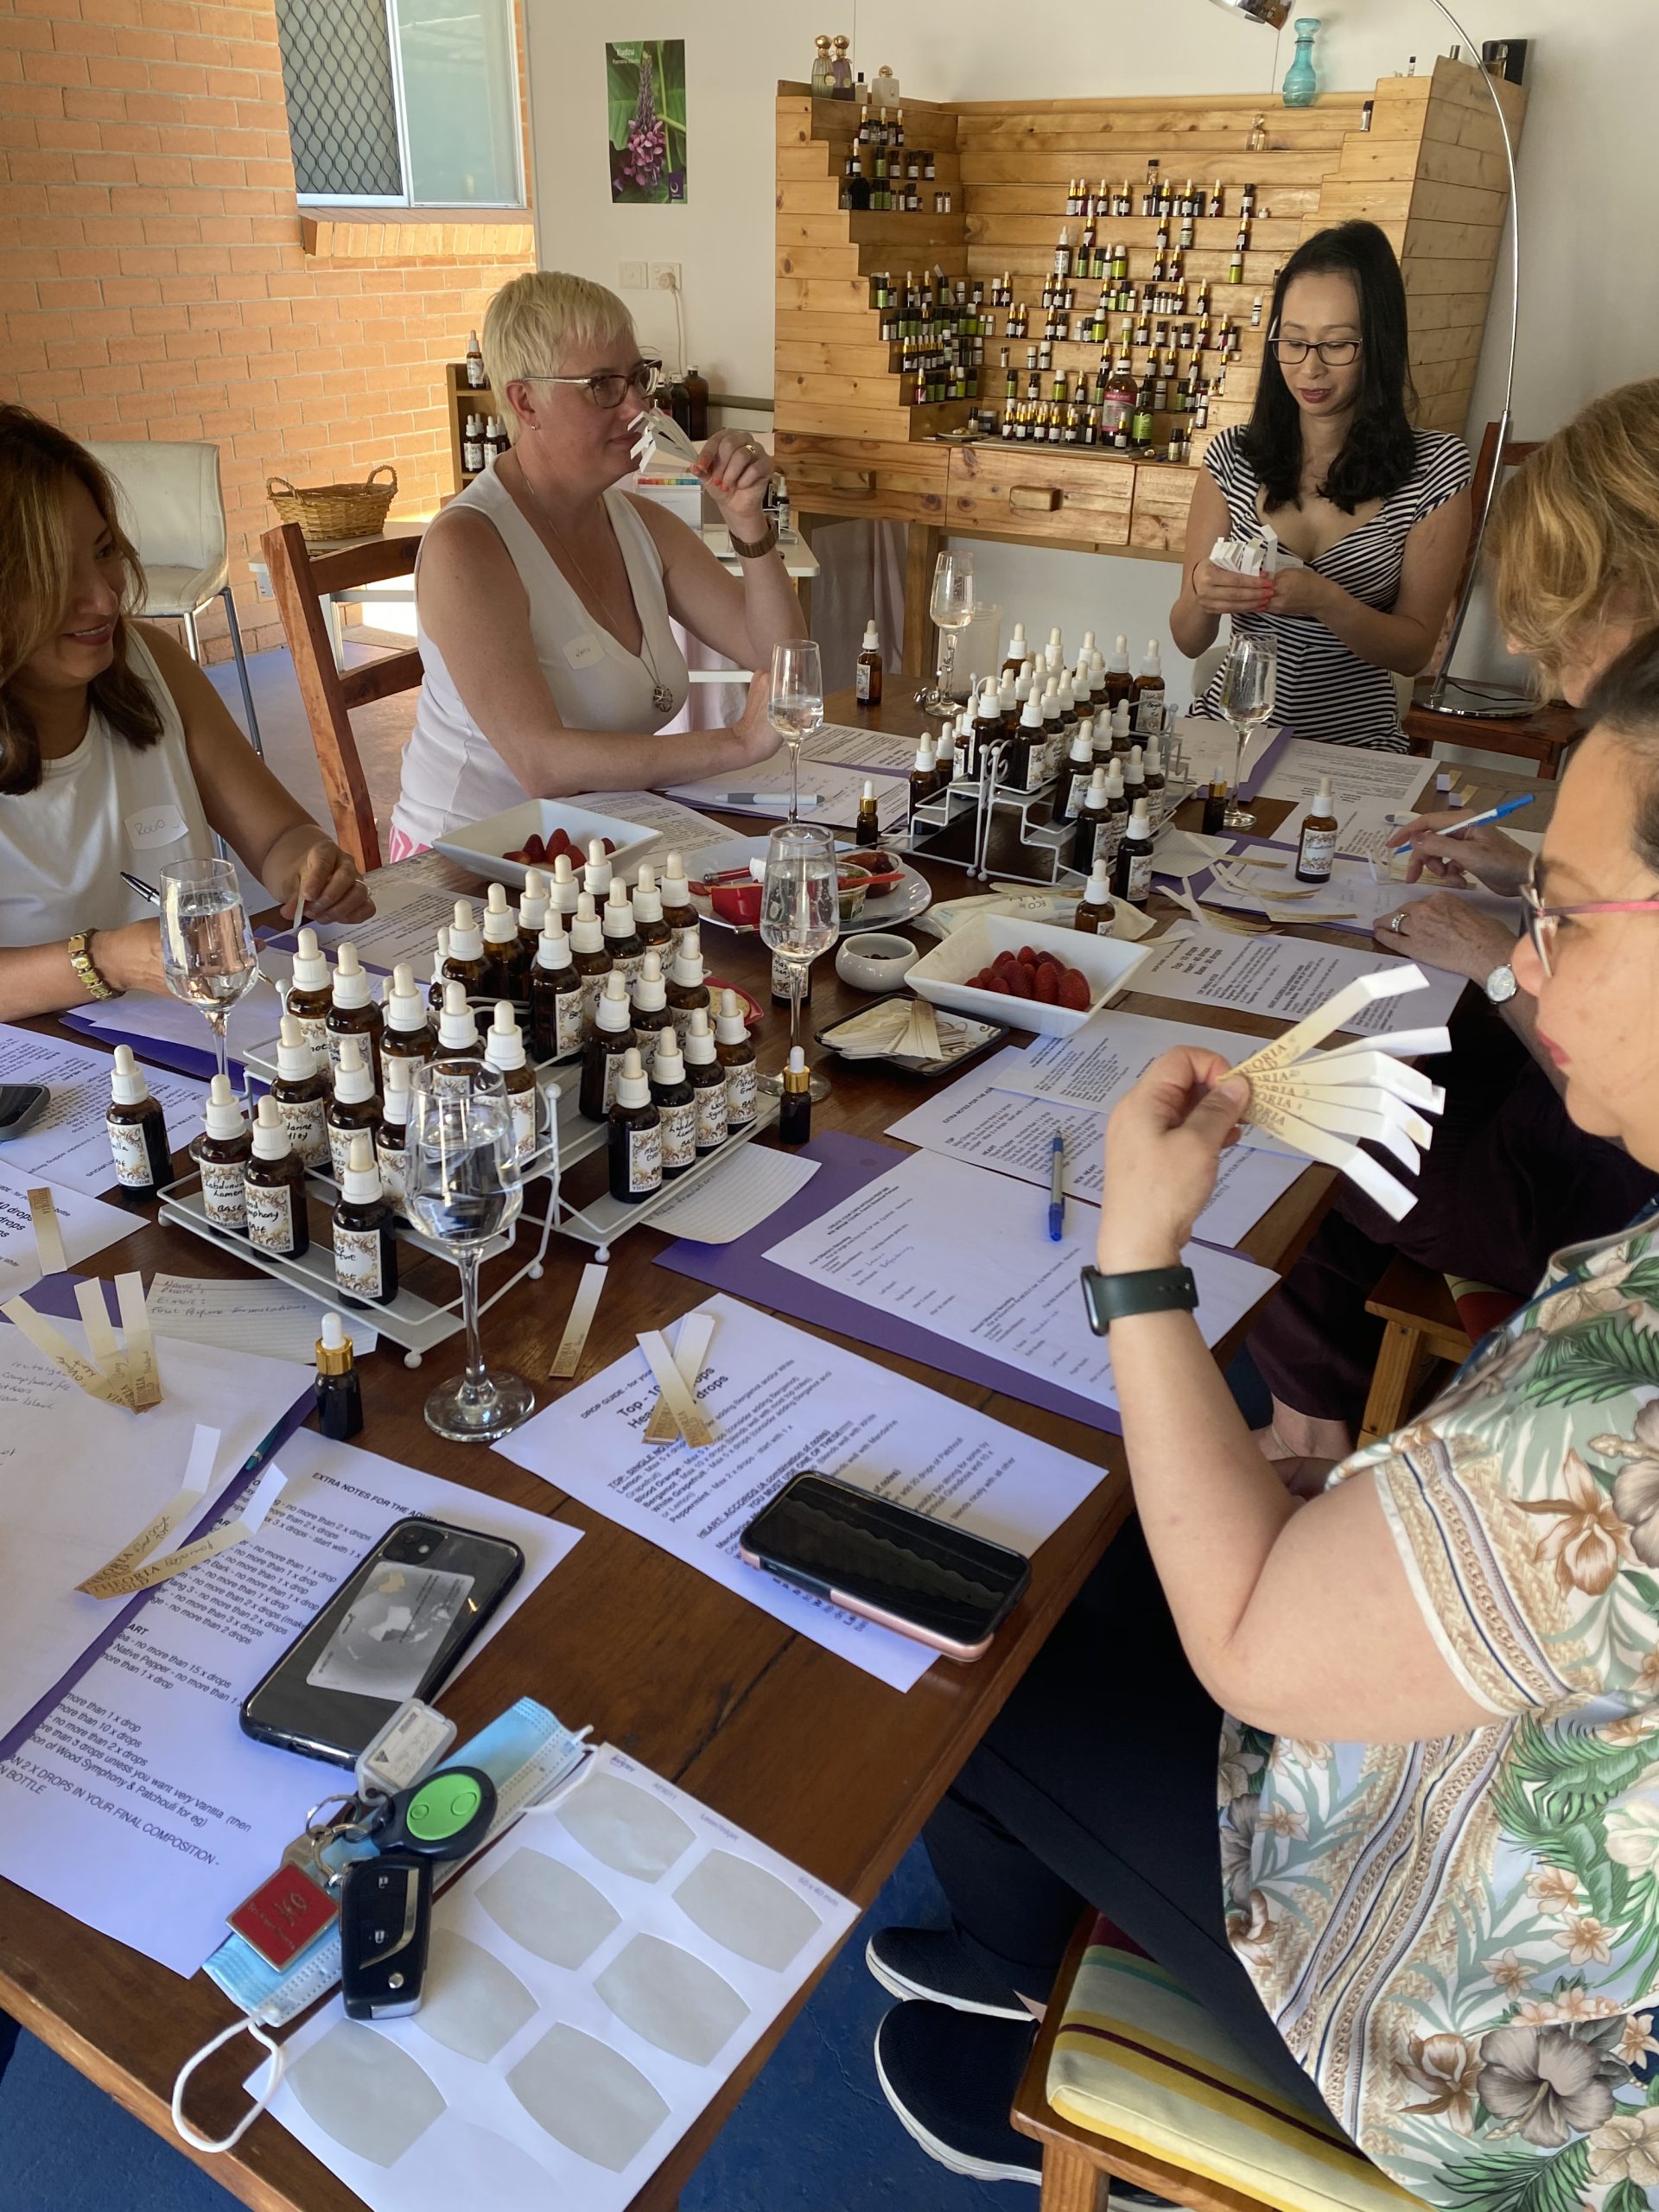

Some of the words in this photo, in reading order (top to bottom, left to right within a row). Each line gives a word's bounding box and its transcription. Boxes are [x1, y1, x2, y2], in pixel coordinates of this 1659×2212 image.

[7, 1206, 33, 1223] drops
[581, 1403, 601, 1418] DROP
[601, 1389, 624, 1403] GUIDE
[696, 1376, 728, 1399] drops
[616, 1402, 642, 1415] Top
[312, 1472, 340, 1486] EXTRA
[341, 1484, 370, 1498] NOTES
[371, 1496, 390, 1505] FOR
[391, 1503, 409, 1513] THE
[92, 1566, 162, 1593] THEORIA
[111, 1577, 149, 1595] GOLD
[210, 1560, 228, 1572] Bark
[246, 1577, 267, 1587] more
[268, 1586, 286, 1597] than
[300, 1599, 319, 1611] drop
[112, 1643, 139, 1659] Native
[139, 1655, 170, 1672] Pepper
[187, 1678, 209, 1691] more
[210, 1688, 229, 1700] than
[146, 1646, 168, 1658] more
[168, 1655, 188, 1668] than
[188, 1664, 200, 1673] 15
[207, 1674, 231, 1688] drops
[5, 1770, 46, 1793] BOTTLE
[52, 1729, 72, 1742] than
[79, 1743, 104, 1758] drops
[104, 1756, 133, 1772] unless
[130, 1770, 150, 1781] you
[151, 1778, 173, 1792] want
[174, 1789, 194, 1803] very
[194, 1799, 223, 1818] Vanilla
[226, 1816, 251, 1831] (then
[55, 1745, 82, 1763] Wood
[81, 1758, 126, 1786] Symphony
[136, 1785, 177, 1810] Patchouli
[176, 1806, 191, 1816] for
[190, 1815, 207, 1827] eg)
[20, 1761, 31, 1770] 2
[28, 1764, 40, 1774] X
[37, 1769, 73, 1791] DROPS
[72, 1787, 86, 1797] IN
[85, 1792, 114, 1812] YOUR
[113, 1808, 141, 1827] FINAL
[143, 1823, 214, 1863] COMPOSITION
